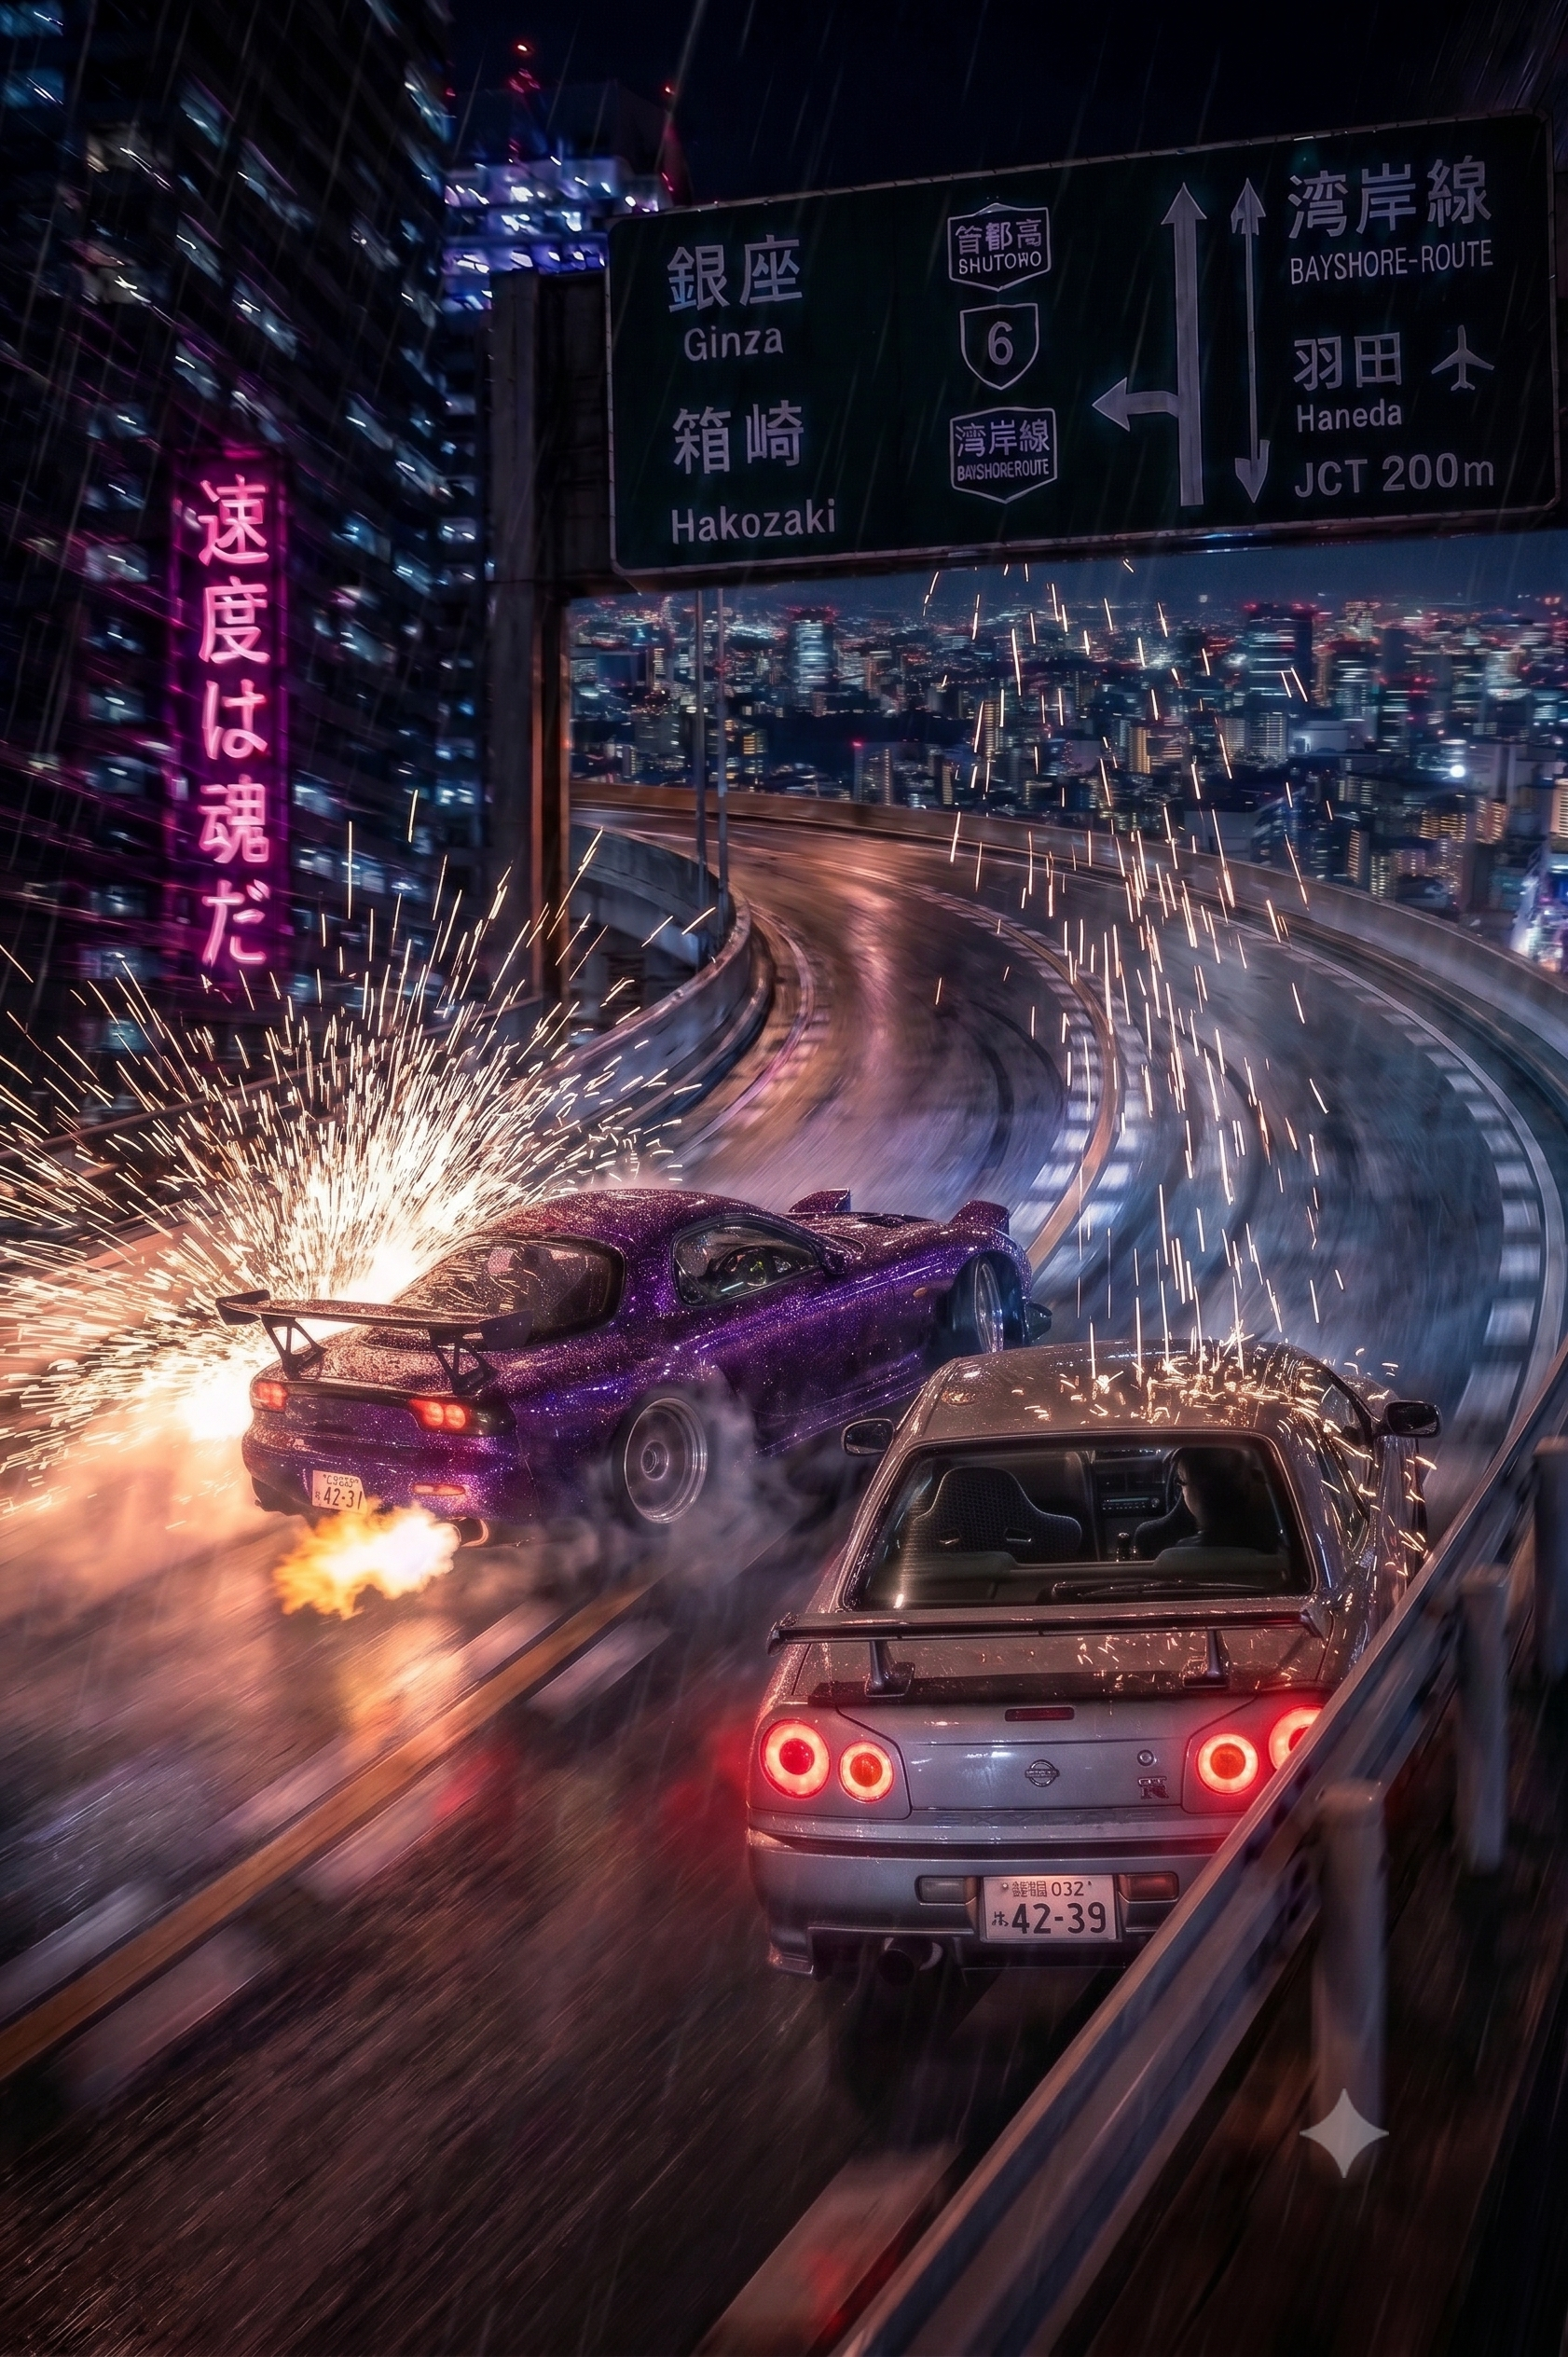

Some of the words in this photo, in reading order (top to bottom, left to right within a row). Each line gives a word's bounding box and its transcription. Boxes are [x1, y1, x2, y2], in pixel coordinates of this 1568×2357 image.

[1288, 156, 1492, 239] 湾岸線
[667, 234, 803, 313] 銀座
[1290, 239, 1493, 285] BAYSHORE-ROUTE
[684, 325, 784, 362] Ginza
[988, 322, 1013, 365] 6
[1293, 332, 1403, 392] 羽田
[672, 400, 805, 475] 箱崎
[955, 418, 1051, 458] 湾岸線
[1297, 398, 1402, 433] Haneda
[1295, 459, 1369, 498] JCT
[1382, 452, 1494, 491] 200m
[671, 499, 836, 544] Hakozaki
[198, 473, 270, 967] 速度は魂だ
[1051, 1881, 1085, 1897] 032
[1011, 1901, 1107, 1935] 42-39
